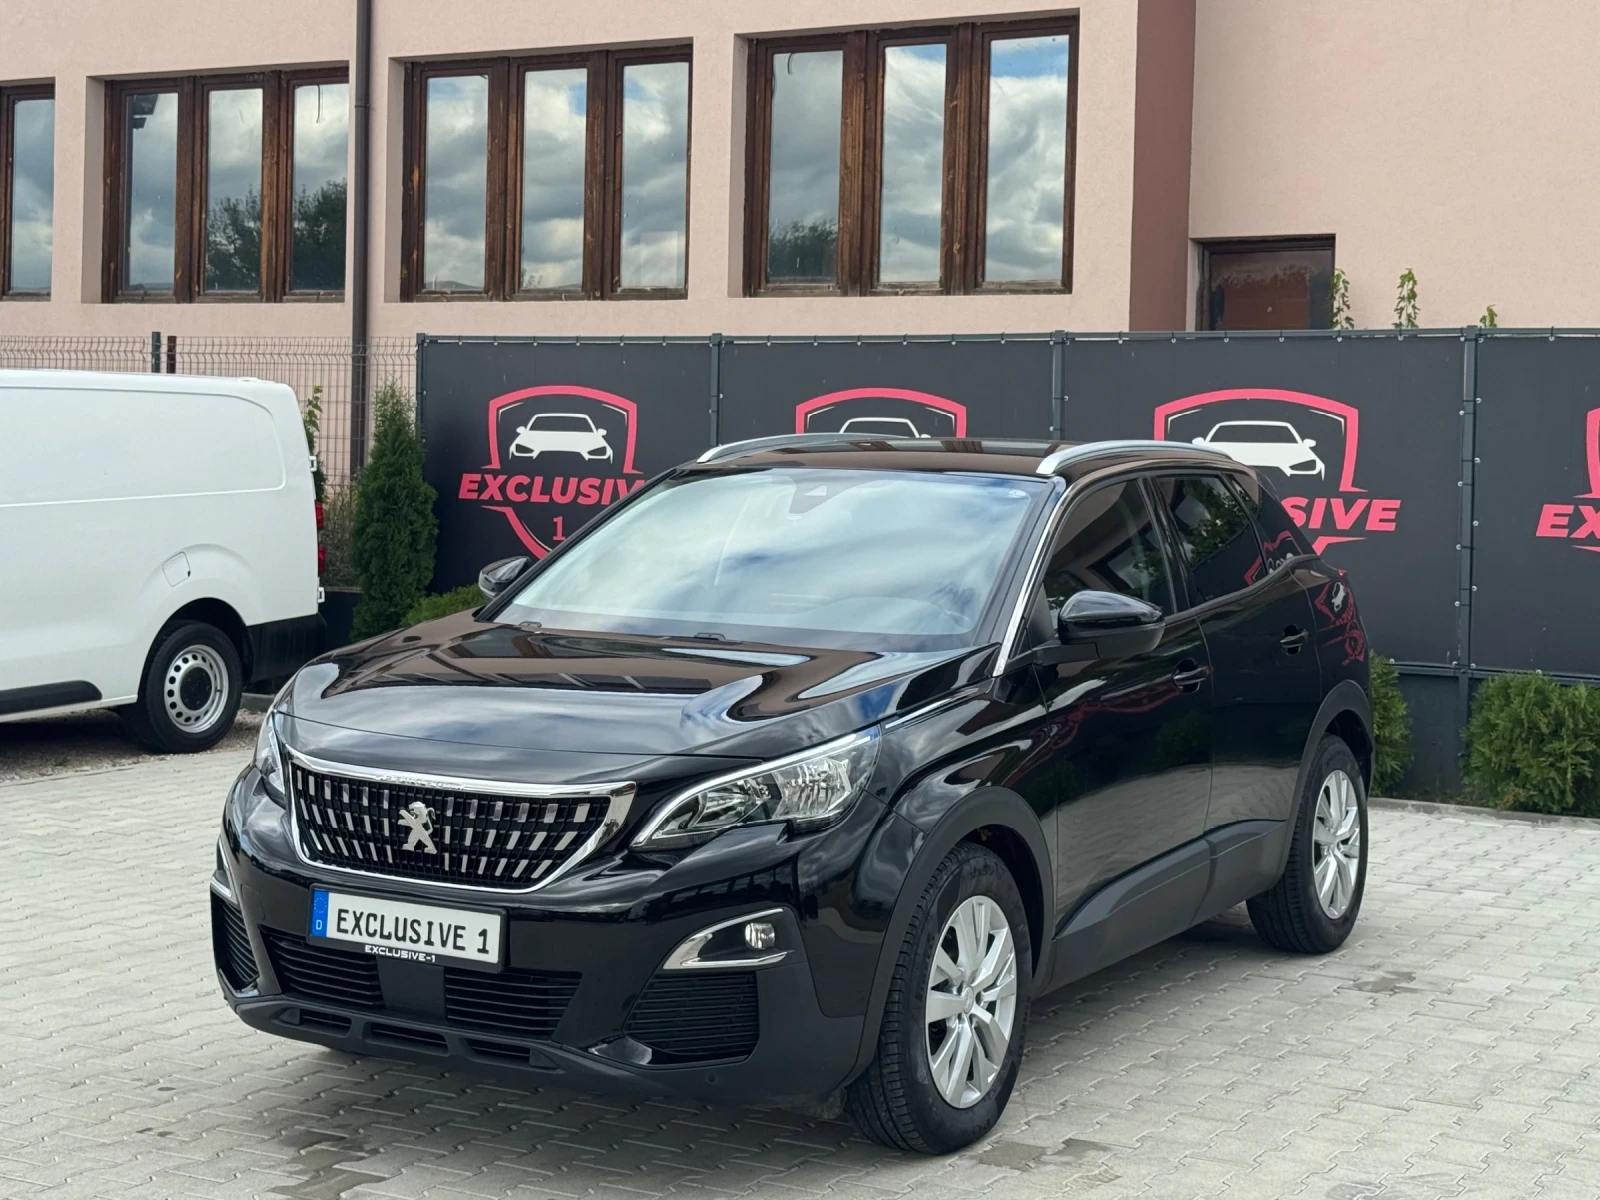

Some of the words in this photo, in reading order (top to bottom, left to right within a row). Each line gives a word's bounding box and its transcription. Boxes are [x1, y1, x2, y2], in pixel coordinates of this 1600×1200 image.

[458, 473, 645, 505] EXCLUSIV
[553, 516, 566, 541] 1
[315, 919, 323, 931] D
[336, 908, 466, 951] EXCLUSIVE
[477, 928, 489, 954] 1
[364, 944, 436, 963] EXCLUSIVE-1
